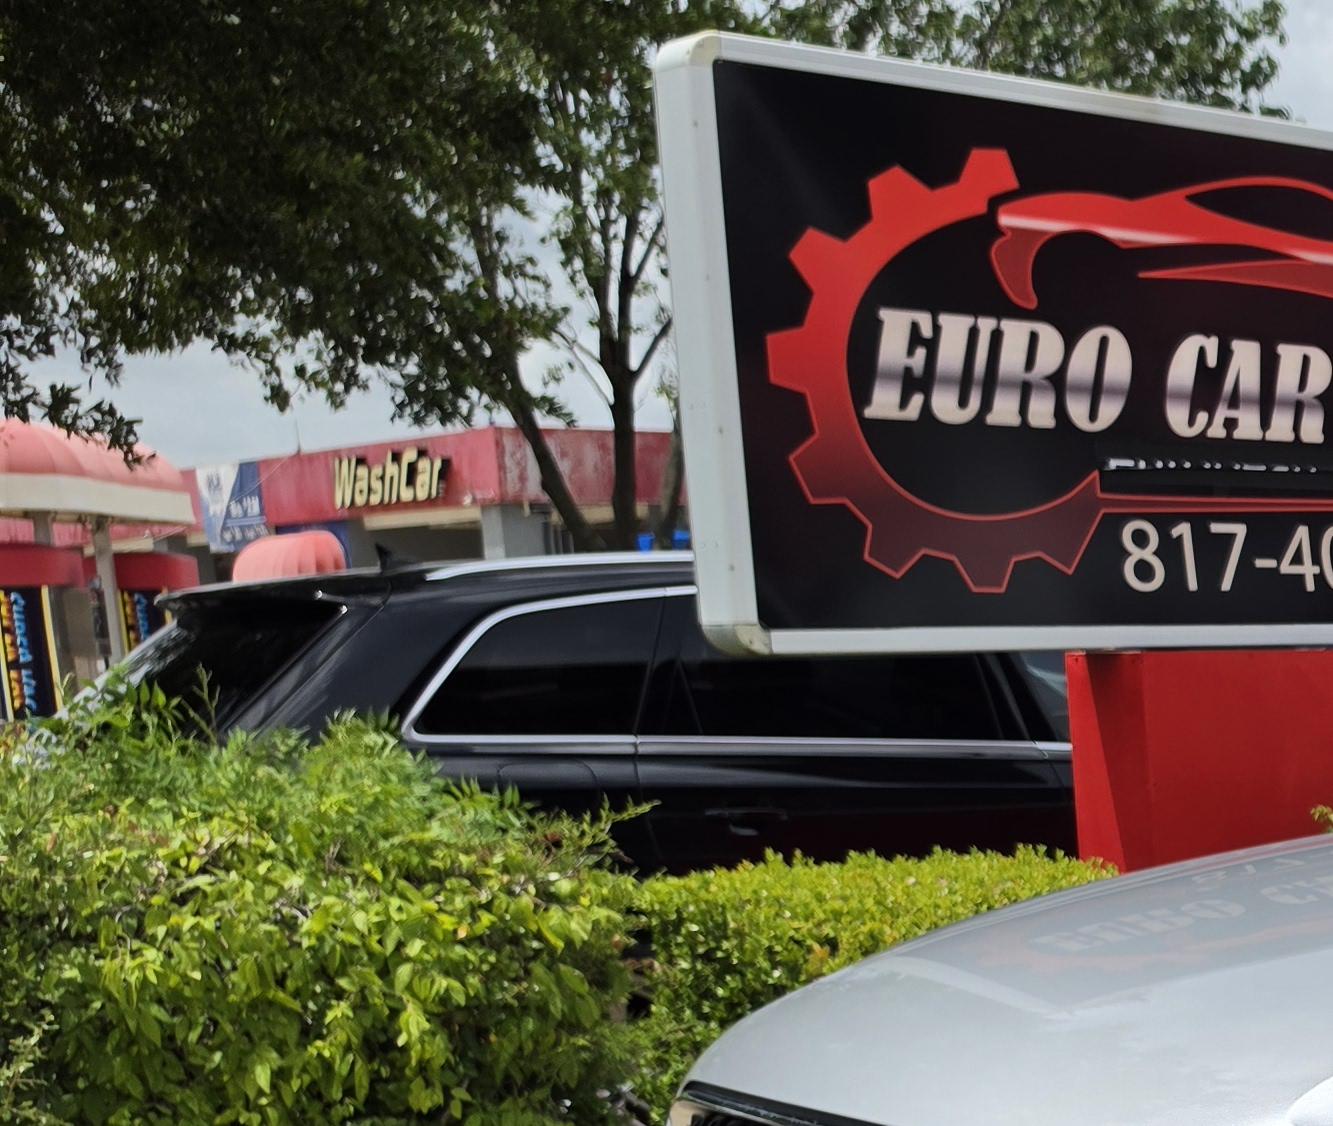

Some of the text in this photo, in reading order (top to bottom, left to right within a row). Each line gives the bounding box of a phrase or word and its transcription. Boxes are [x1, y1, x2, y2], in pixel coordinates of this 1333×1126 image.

[863, 306, 1134, 433] EURO
[1165, 334, 1333, 444] CAR
[335, 445, 443, 510] WashCar
